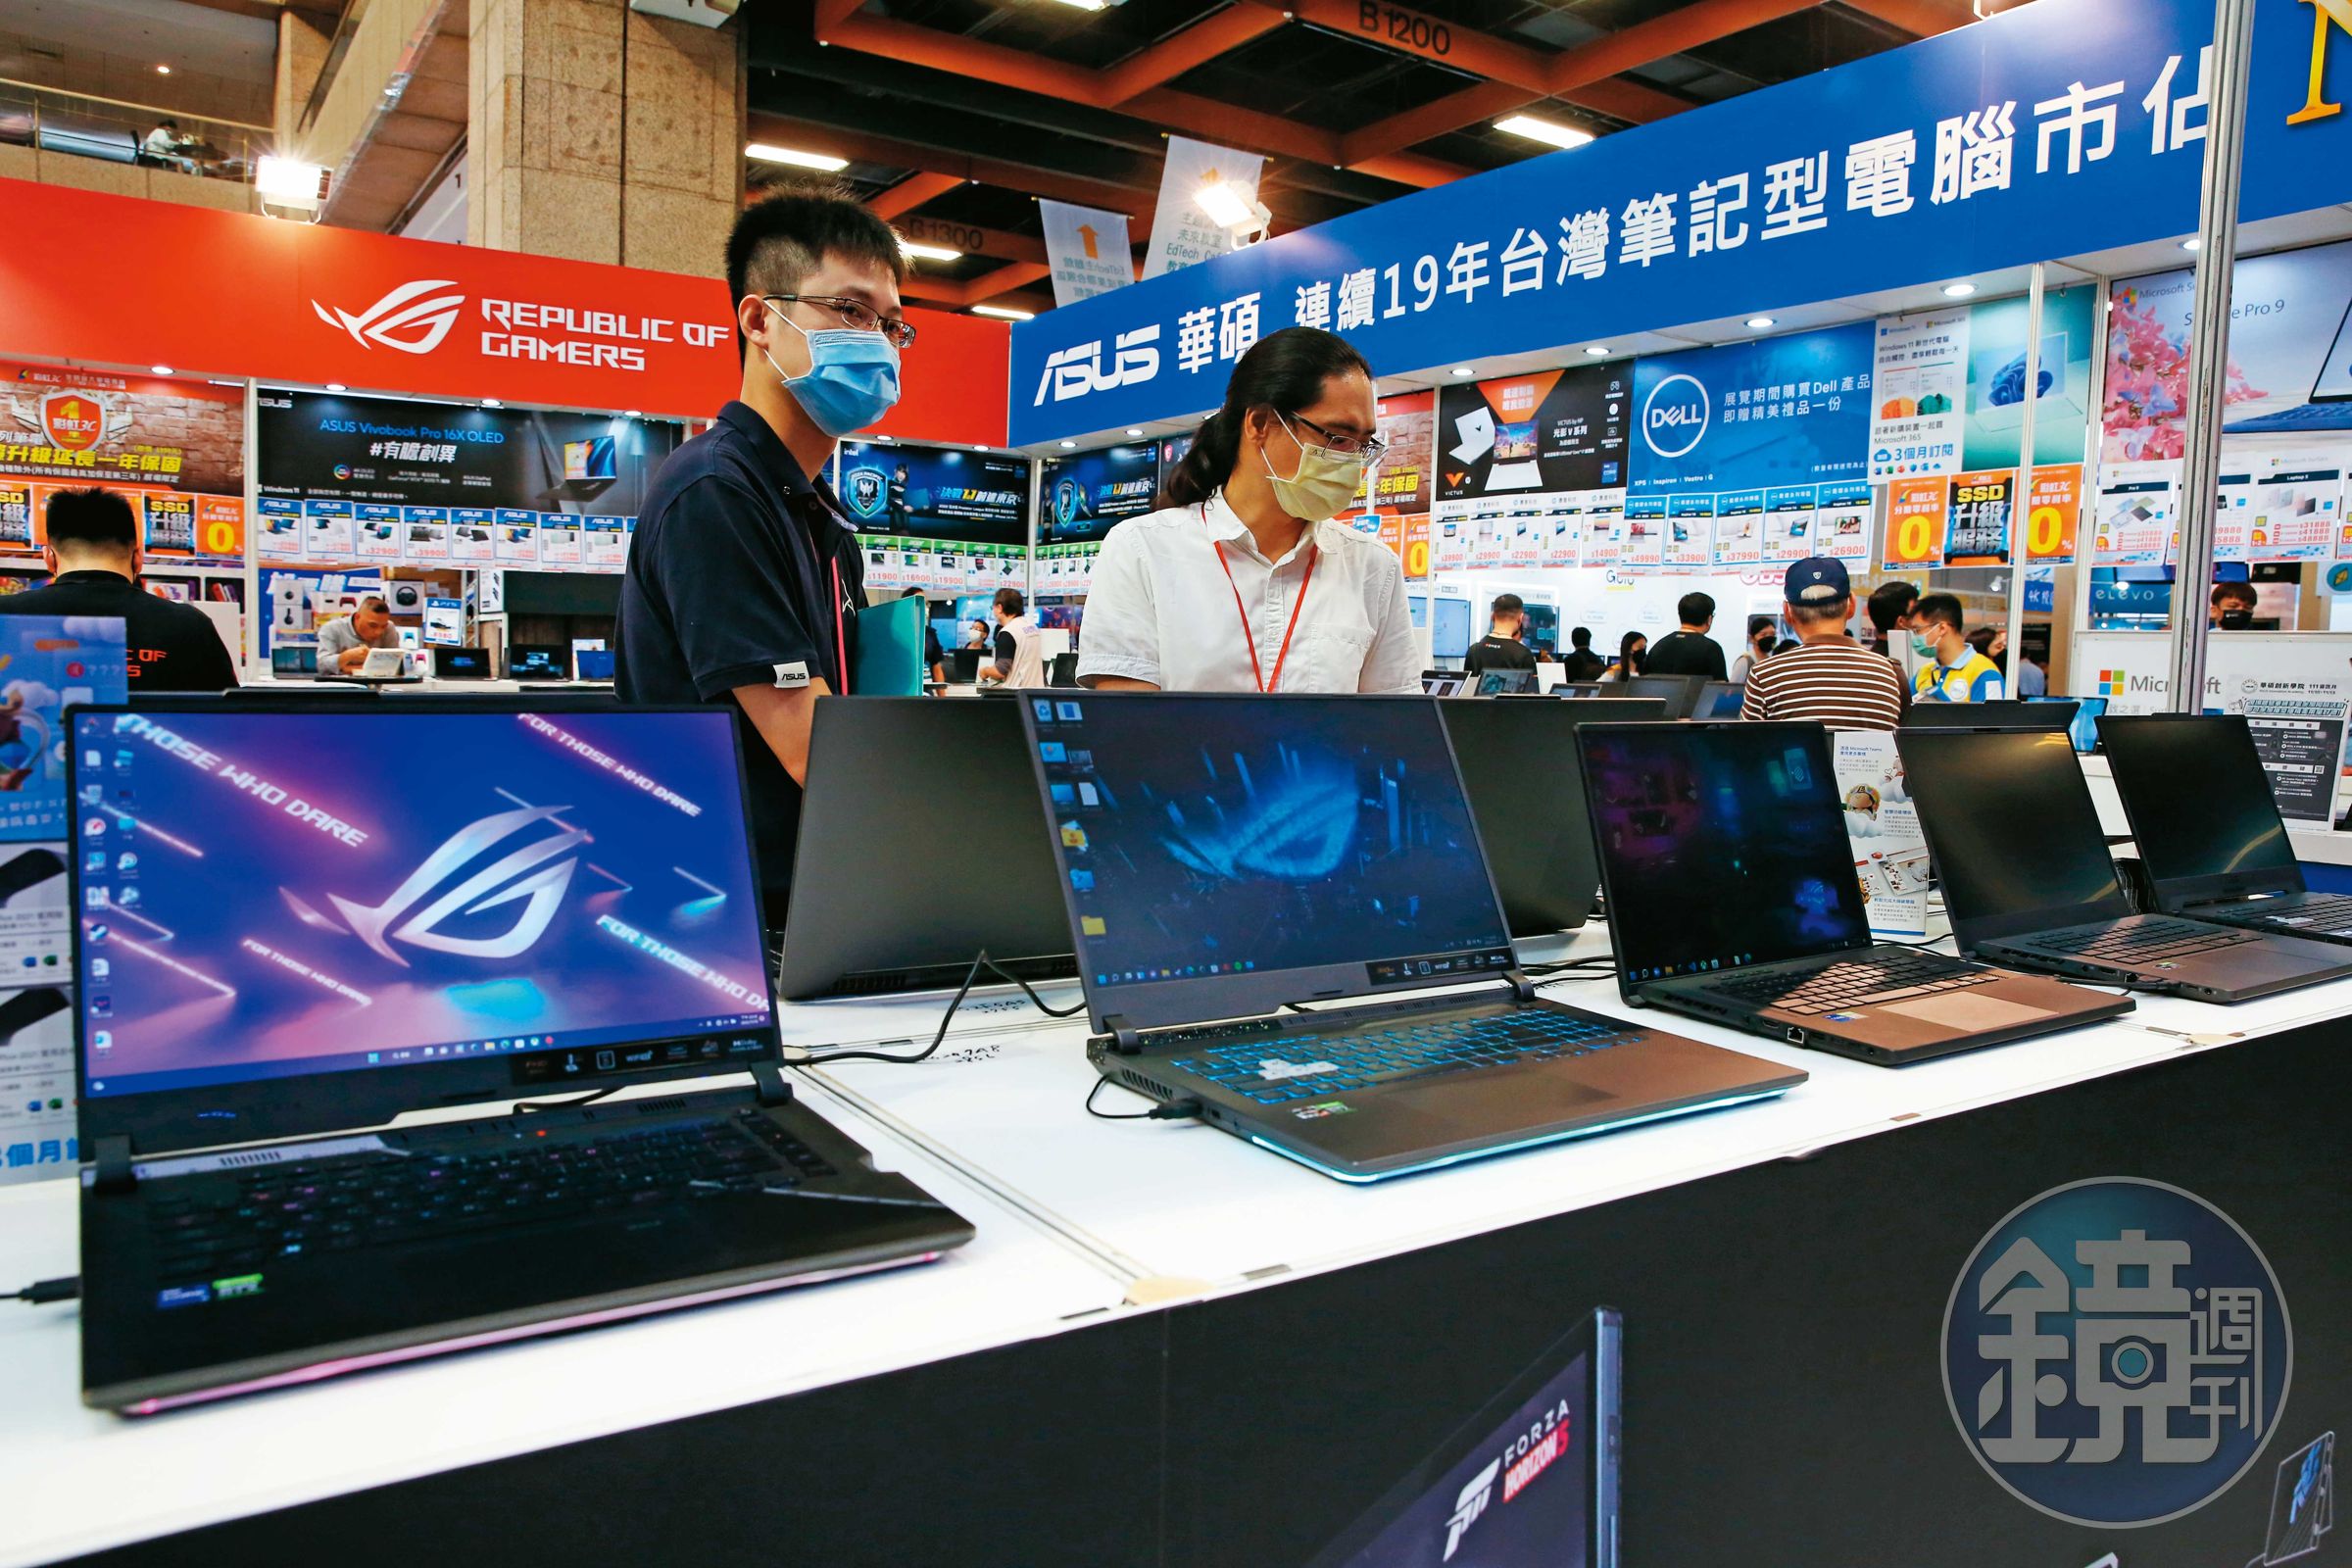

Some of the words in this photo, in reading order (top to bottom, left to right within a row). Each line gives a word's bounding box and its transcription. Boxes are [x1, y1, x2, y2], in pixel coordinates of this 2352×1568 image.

[1166, 242, 1200, 260] EdTech
[2138, 282, 2184, 299] Microsoft
[2244, 304, 2271, 318] Pro
[2275, 299, 2285, 313] 9
[481, 298, 675, 343] REPUBLIC
[682, 321, 731, 348] OF
[1178, 292, 1261, 374] 華碩
[481, 331, 646, 371] GAMERS
[1879, 341, 1907, 353] Windows
[1034, 324, 1160, 407] ASUS
[1650, 404, 1702, 428] DELL
[1723, 395, 1842, 424] 即贈精美禮品一份
[320, 419, 356, 433] ASUS
[359, 421, 416, 438] Vivobook
[420, 426, 441, 440] Pro
[444, 428, 466, 441] 16X
[467, 431, 505, 444] OLED
[1874, 433, 1908, 445] Microsoft
[1908, 433, 1922, 442] 365
[1893, 443, 1955, 462] 3個月訂閱
[1652, 477, 1678, 486] Inspiron
[1956, 484, 2005, 503] SSD
[150, 500, 190, 514] SSD
[1953, 501, 2006, 529] 升級
[1726, 551, 1760, 562] $37990
[1776, 549, 1811, 559] $29900
[1830, 545, 1866, 556] $26900
[139, 649, 168, 662] OF
[781, 672, 807, 681] ASUS
[558, 731, 617, 770] THOSE
[614, 764, 655, 792] WHO
[653, 785, 704, 818] DARE
[219, 764, 288, 807] WHO
[284, 799, 369, 848] DARE
[242, 938, 272, 960] FOR
[270, 949, 315, 978] THOSE
[595, 913, 641, 945] FOR
[638, 935, 709, 979] THOSE
[704, 967, 749, 1001] WHO
[1503, 1397, 1570, 1469] FORZA
[1502, 1431, 1558, 1503] HORIZON
[1555, 1418, 1571, 1456] 5
